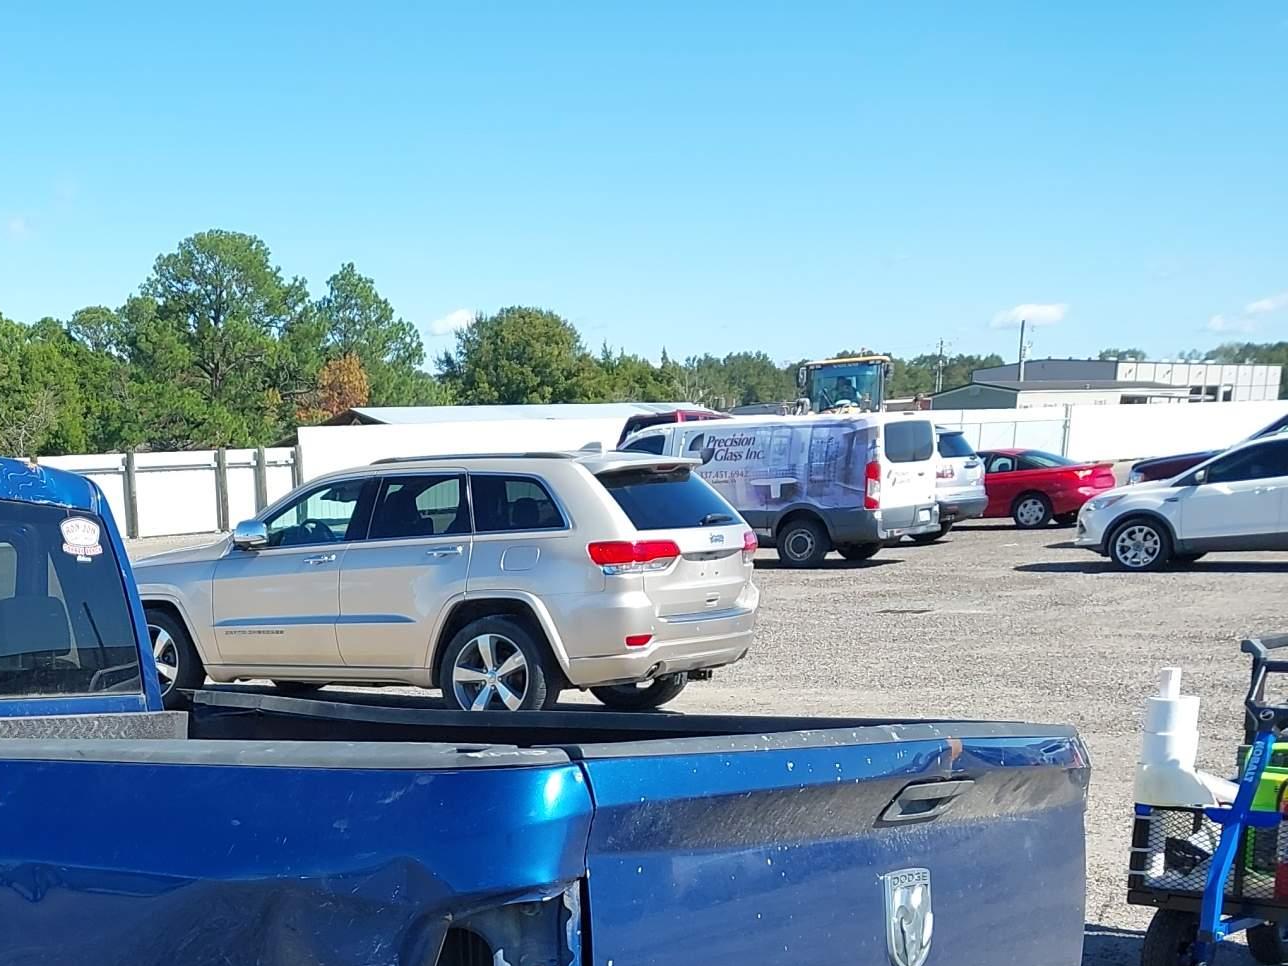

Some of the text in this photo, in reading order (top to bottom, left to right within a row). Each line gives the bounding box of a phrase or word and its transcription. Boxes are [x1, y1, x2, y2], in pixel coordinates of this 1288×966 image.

[706, 432, 756, 448] Precision
[713, 448, 765, 462] Glass Inc.
[1243, 740, 1265, 782] KOBALT
[892, 872, 928, 886] DODGE
